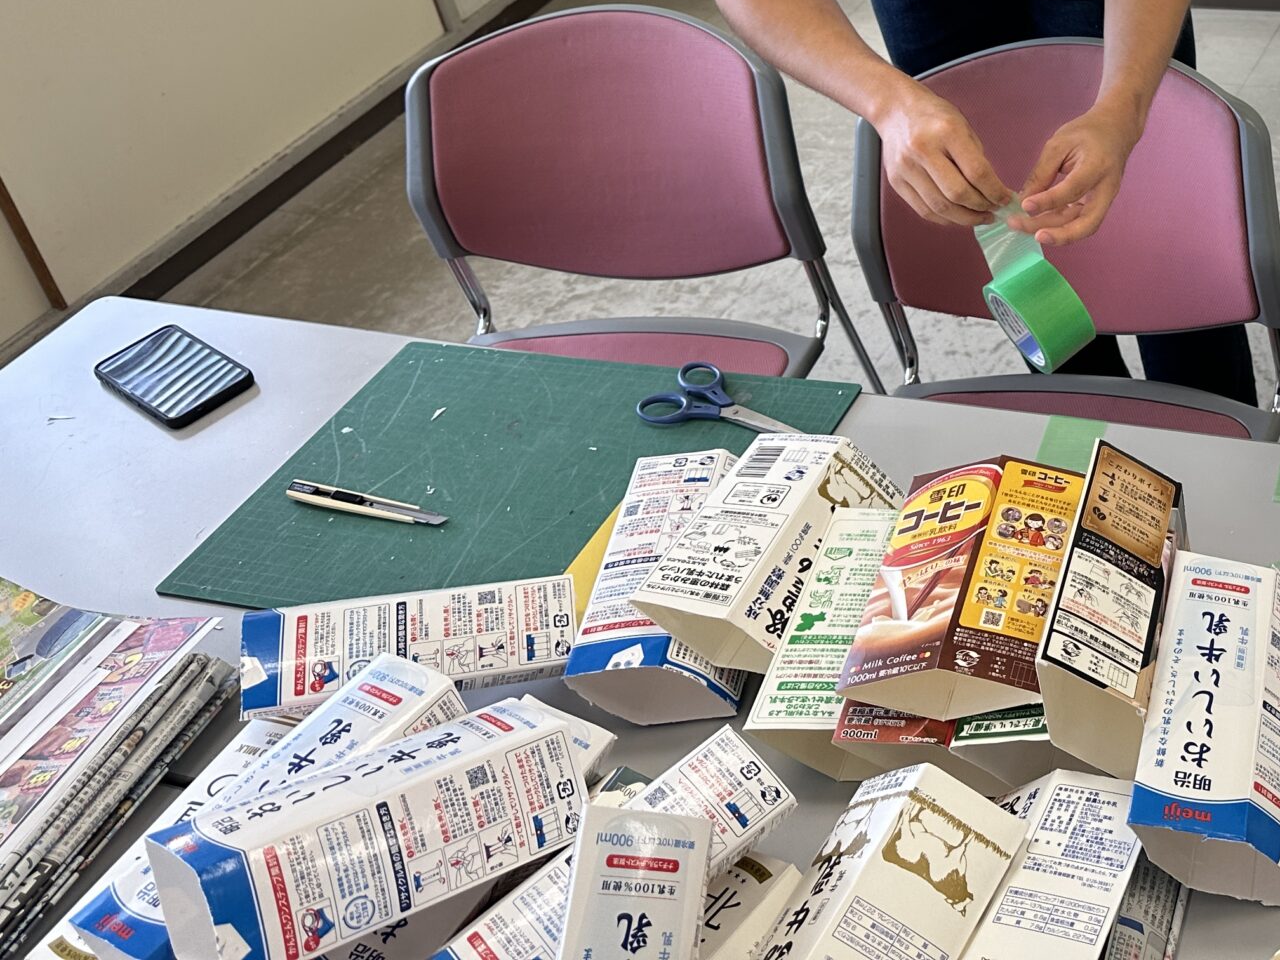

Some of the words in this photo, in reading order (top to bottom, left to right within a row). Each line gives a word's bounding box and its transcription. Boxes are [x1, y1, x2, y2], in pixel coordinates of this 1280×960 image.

[1020, 468, 1035, 478] 雪印
[1037, 470, 1071, 485] コーヒー
[1106, 458, 1166, 497] こだわりポイント
[929, 483, 967, 507] 雪印
[897, 497, 983, 536] コーヒー
[928, 524, 957, 537] 乳飲料
[658, 565, 743, 585] うまれた牛乳パック
[1183, 564, 1212, 577] 900ml
[661, 574, 731, 592] 森林の恵みから
[745, 564, 786, 621] 成分無調整
[704, 592, 731, 605] 広報欄
[1188, 592, 1249, 609] 生乳100%使用
[1235, 627, 1248, 646] 牛乳
[862, 658, 883, 671] Milk
[886, 651, 918, 666] Coffee
[846, 671, 878, 685] 1000ml
[878, 662, 928, 678] 要冷蔵10℃以下
[1154, 628, 1185, 768] 新鮮な生乳のおいしさ、そのまま
[1180, 610, 1232, 769] おいしい牛乳
[338, 695, 387, 721] 生乳100%使用
[768, 695, 844, 705] 美濃せいきょう牛乳
[767, 708, 835, 718] みんなで利用しよう
[841, 730, 878, 740] 900ml
[968, 714, 1045, 736] 果汁でいい準備!
[248, 732, 462, 821] おいしい牛乳
[514, 751, 537, 813] 注ぎ口をつけたままで
[521, 748, 544, 810] 紙パックとしてリサイクルへ
[1173, 771, 1212, 792] 明治
[1087, 790, 1099, 798] 牛乳
[500, 766, 526, 847] 洗って乾かしてリサイクルへ
[1164, 805, 1211, 823] meiji
[211, 815, 242, 835] 明治
[596, 832, 634, 846] 900ml
[378, 802, 409, 911] リサイクル時の簡単な開き方
[601, 882, 677, 896] 生乳100%使用
[999, 905, 1025, 916] たんぱく質
